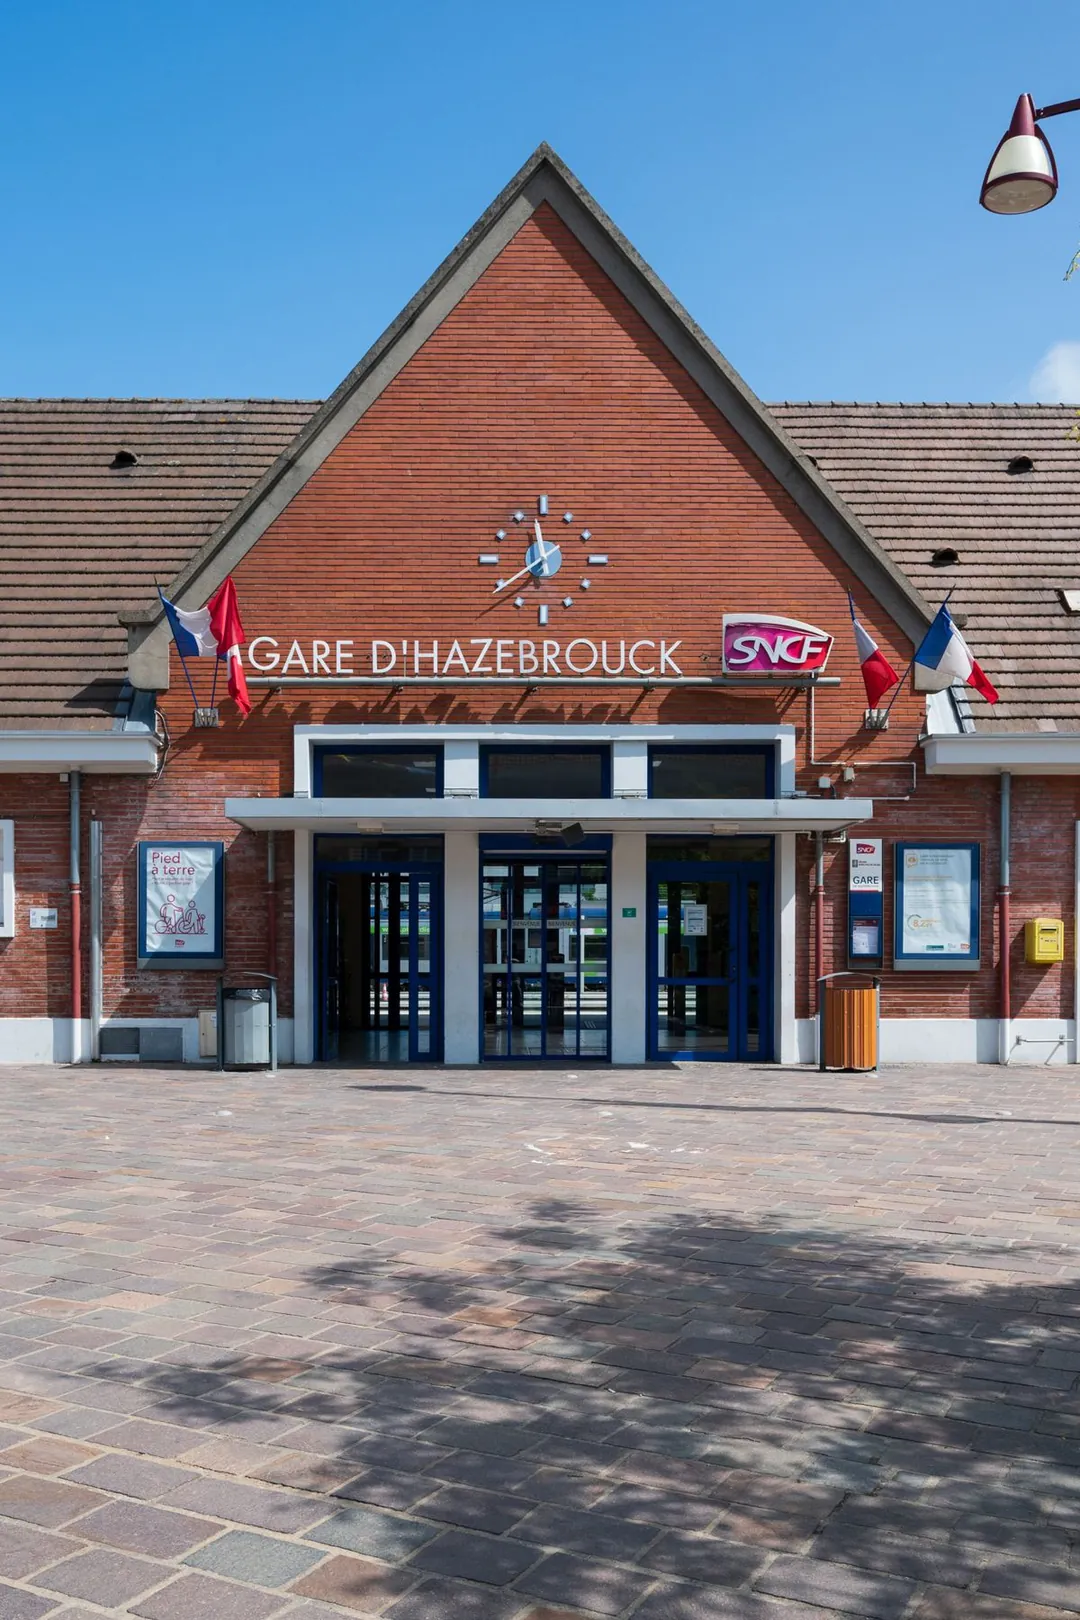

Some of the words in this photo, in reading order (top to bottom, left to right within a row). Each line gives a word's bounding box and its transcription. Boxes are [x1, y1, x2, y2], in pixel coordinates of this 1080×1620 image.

[248, 636, 354, 674] GARE
[372, 638, 683, 674] D'HAZEBROUCK
[728, 635, 829, 664] SNCF
[152, 852, 181, 864] Pied
[151, 864, 159, 875] à
[163, 865, 195, 875] terre
[852, 876, 879, 885] GARE
